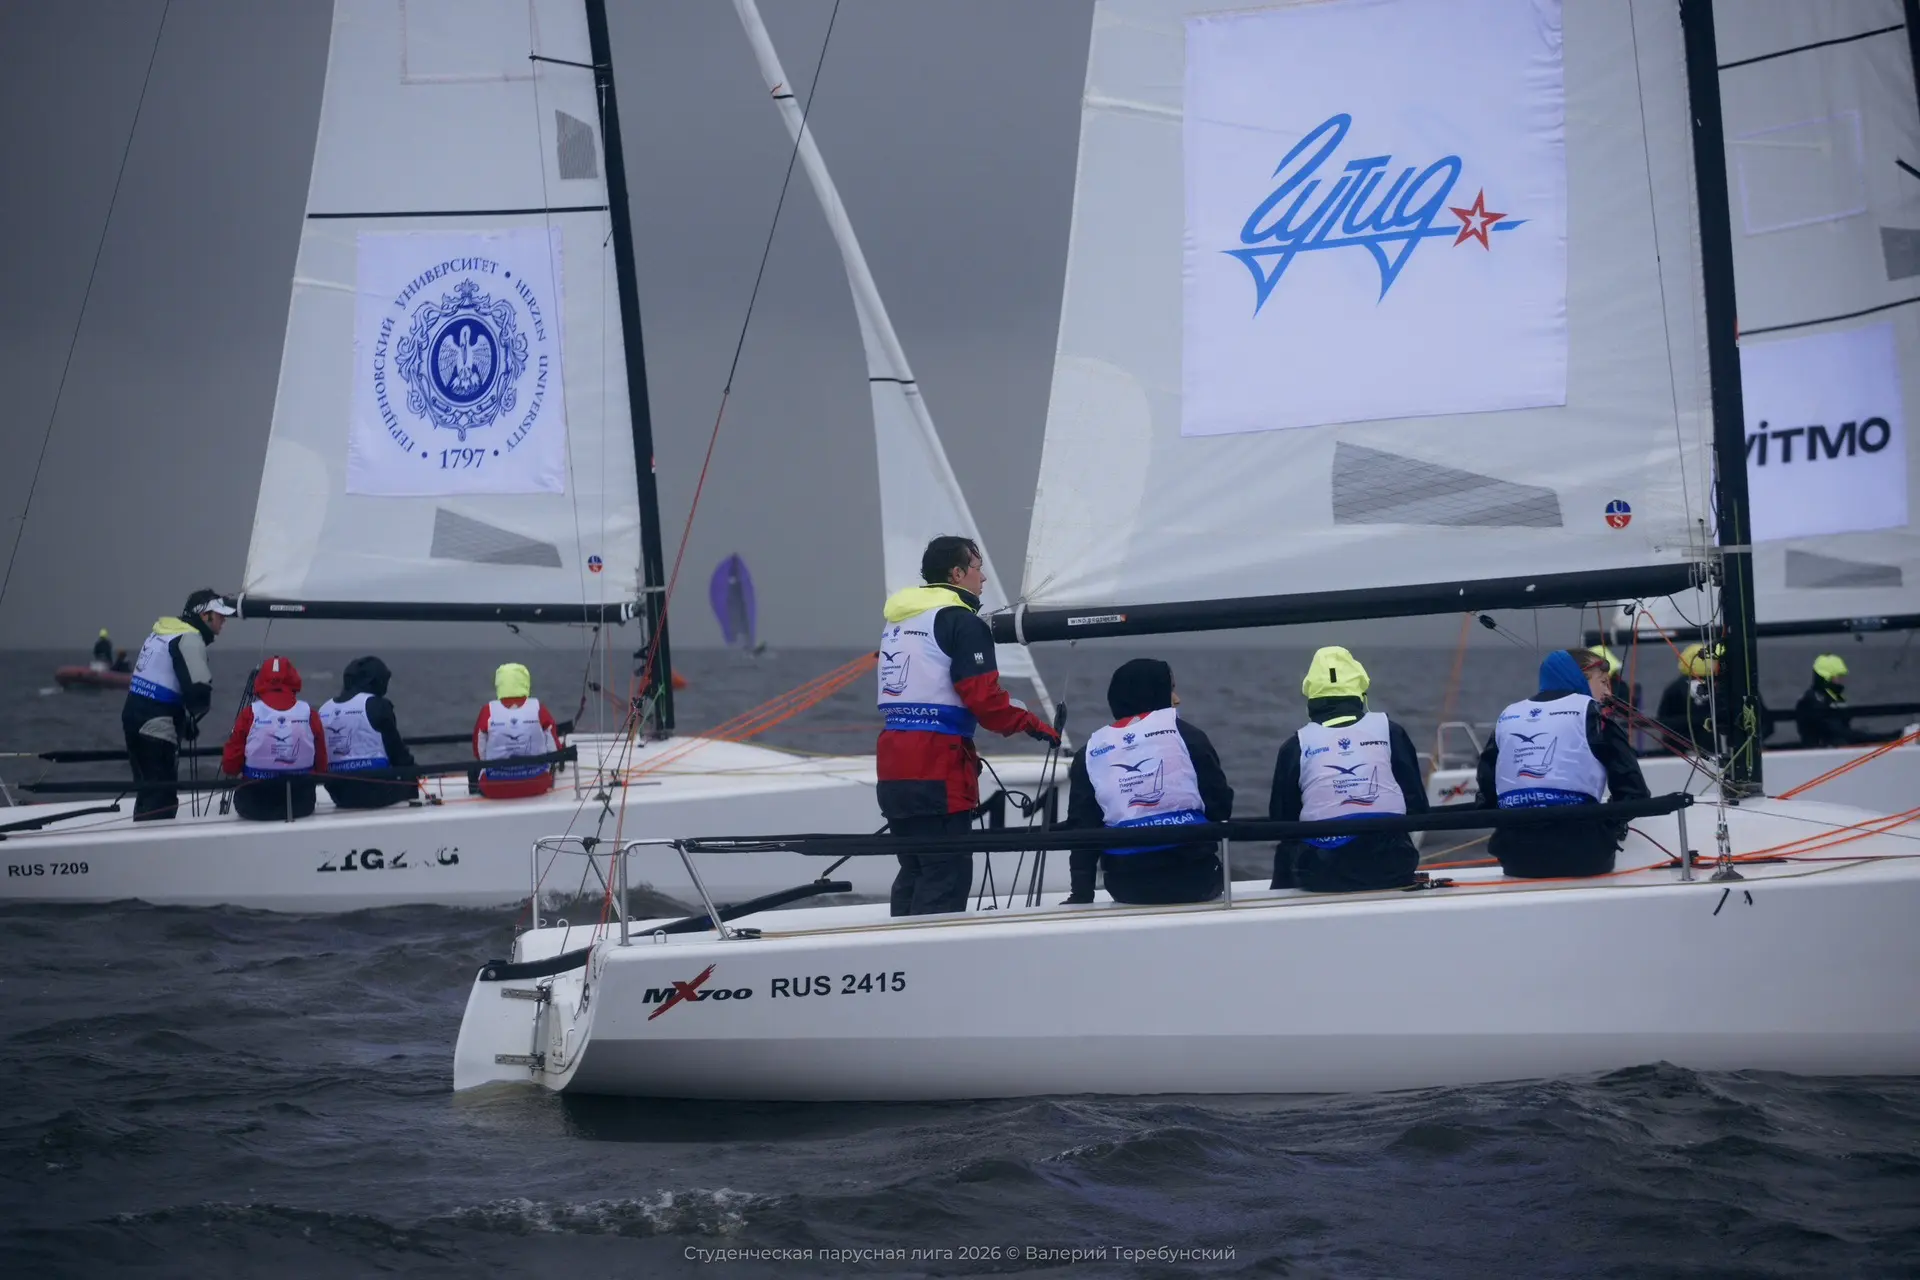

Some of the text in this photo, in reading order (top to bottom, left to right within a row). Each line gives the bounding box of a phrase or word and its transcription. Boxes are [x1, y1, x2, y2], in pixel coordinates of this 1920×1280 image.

[374, 257, 499, 453] ГЕРЦЕНОВСКИЙ УНИВЕРСИТЕТ
[506, 279, 548, 452] HERZEN UNIVERSITY
[439, 448, 486, 470] 1797
[8, 861, 89, 877] RUS 7209
[317, 847, 460, 872] ZIGZG
[642, 964, 907, 1021] MX700 RUS 2415
